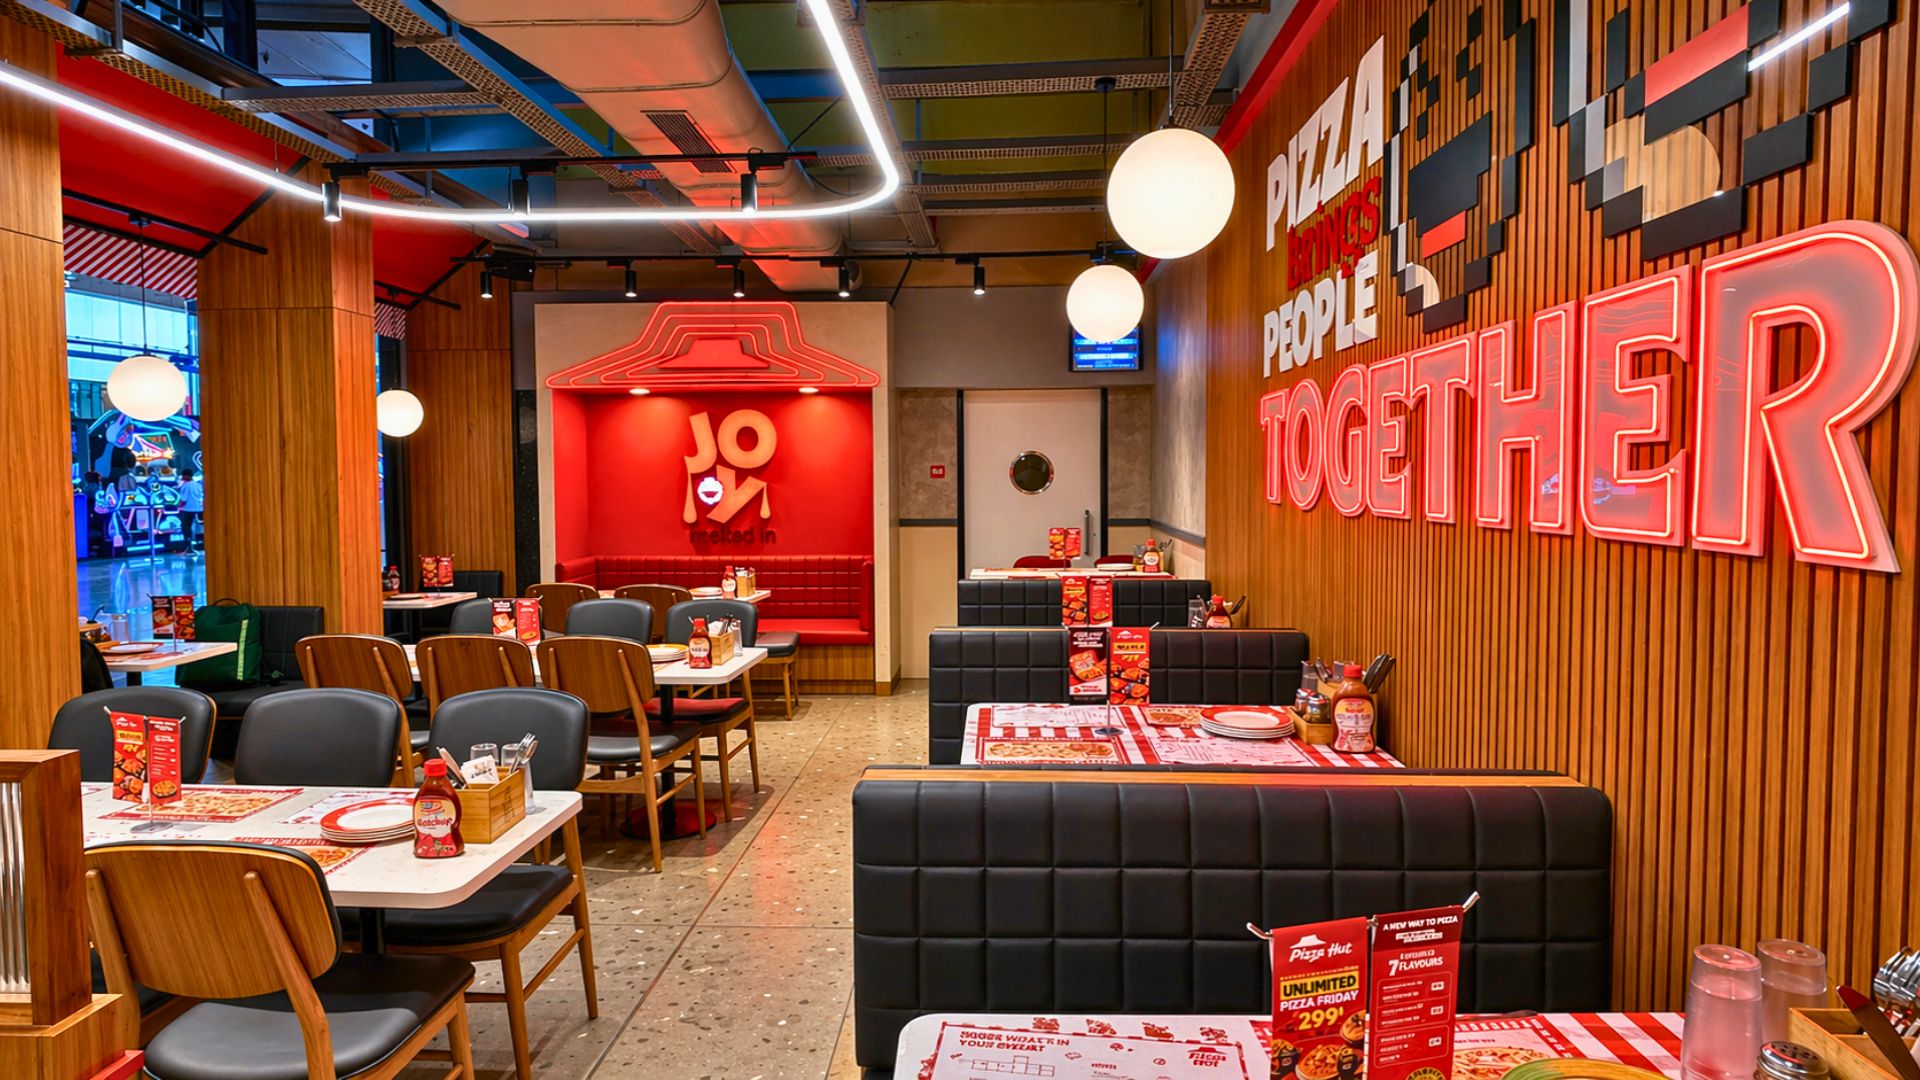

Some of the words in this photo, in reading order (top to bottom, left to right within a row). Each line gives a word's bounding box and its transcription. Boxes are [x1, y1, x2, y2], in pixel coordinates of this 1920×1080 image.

[1266, 35, 1384, 252] PIZZA
[1263, 249, 1379, 379] PEOPLE
[1260, 220, 1919, 573] TOGETHER
[690, 526, 754, 544] melted
[760, 527, 776, 544] in
[1383, 923, 1389, 931] A
[1389, 922, 1407, 931] NEW
[1408, 919, 1425, 928] WAY
[1426, 918, 1436, 926] TO
[1437, 916, 1459, 925] PIZZA
[1289, 948, 1325, 963] Pizza
[1327, 942, 1353, 958] Hut
[1388, 959, 1399, 976] 7
[1399, 957, 1444, 971] FLAVOURS
[1283, 975, 1357, 997] UNLIMITED
[1280, 997, 1316, 1012] PIZZA
[1317, 990, 1359, 1006] FRIDAY
